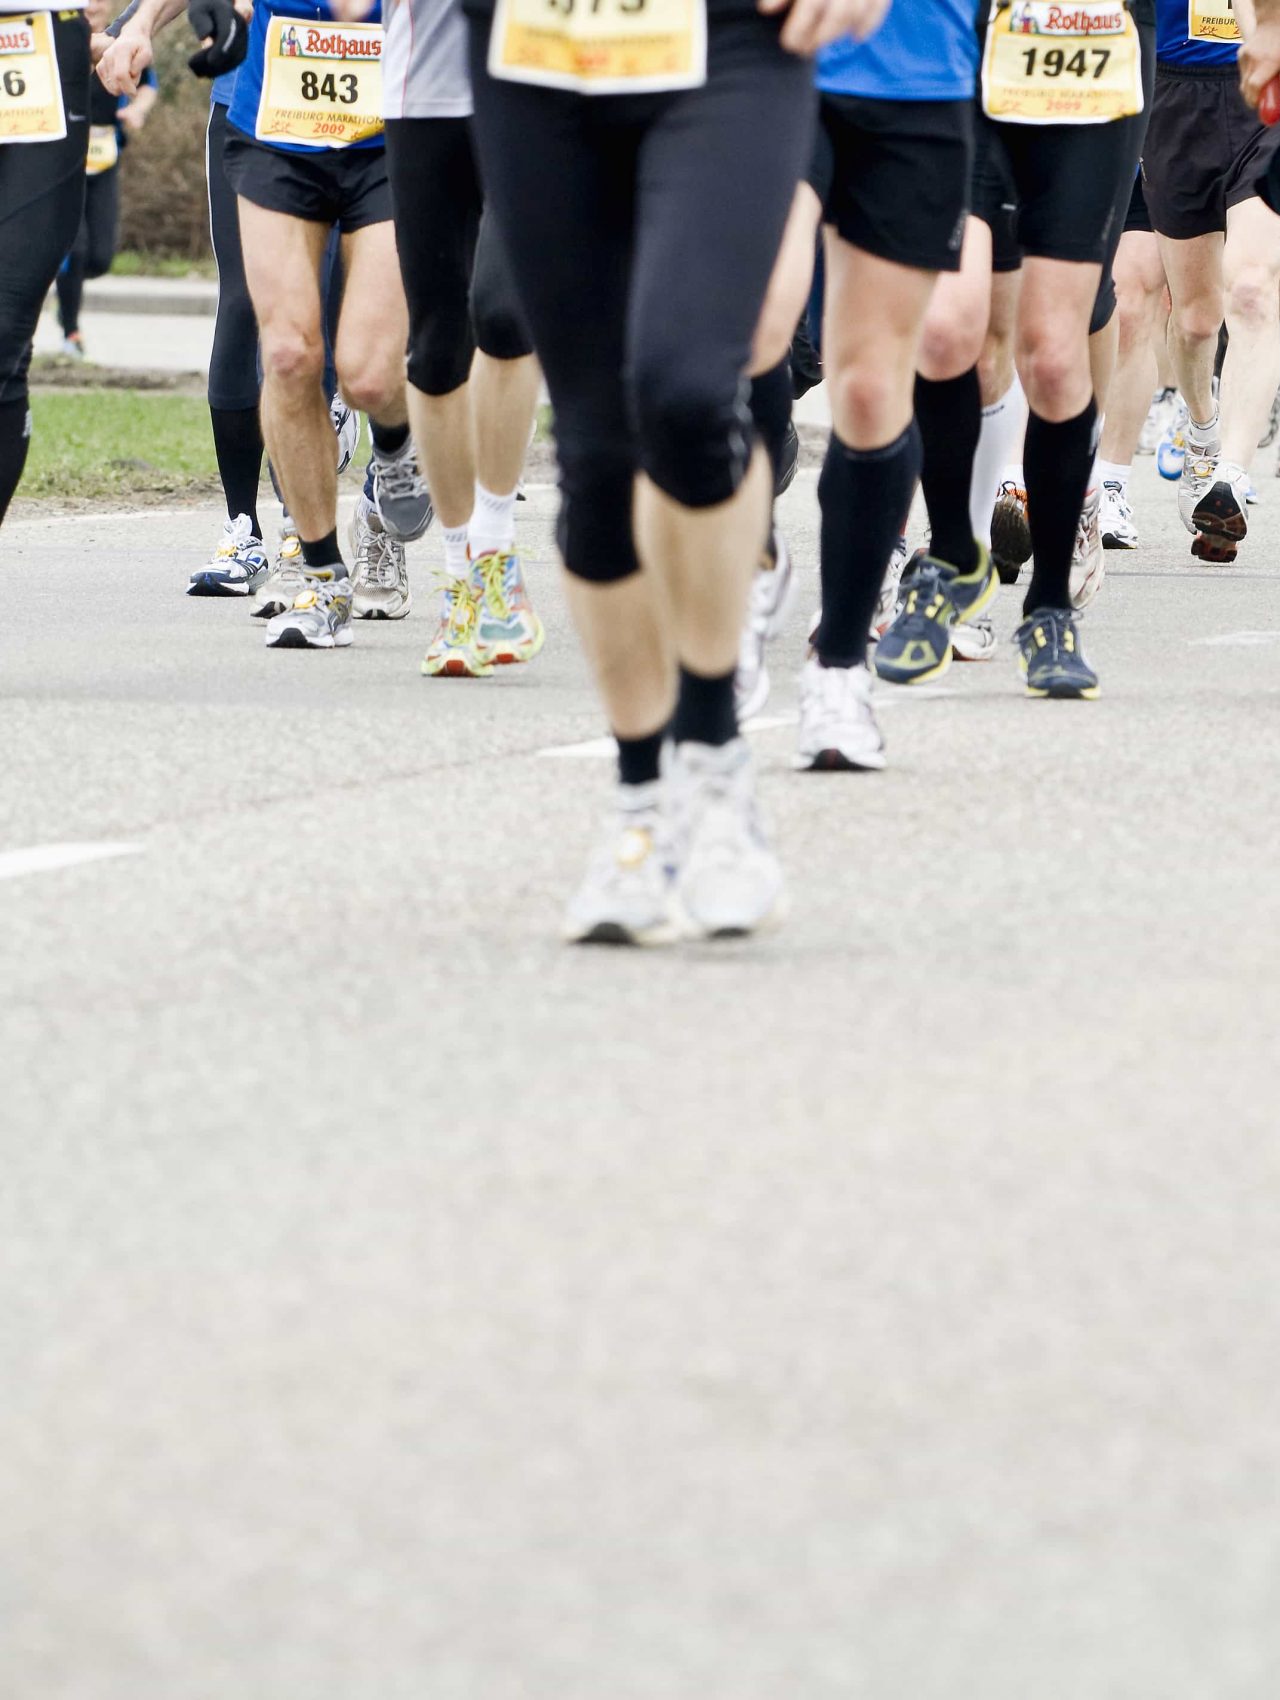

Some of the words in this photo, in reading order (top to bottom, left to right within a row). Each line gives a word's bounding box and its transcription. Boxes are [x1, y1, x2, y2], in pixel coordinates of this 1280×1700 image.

[1045, 6, 1122, 36] Rothaus
[1202, 16, 1238, 25] FREIBUR
[305, 29, 382, 59] Rothaus
[1022, 47, 1111, 79] 1947
[0, 70, 26, 97] 6
[301, 71, 358, 104] 843
[276, 110, 324, 121] FREIBURG
[313, 122, 345, 135] 2009
